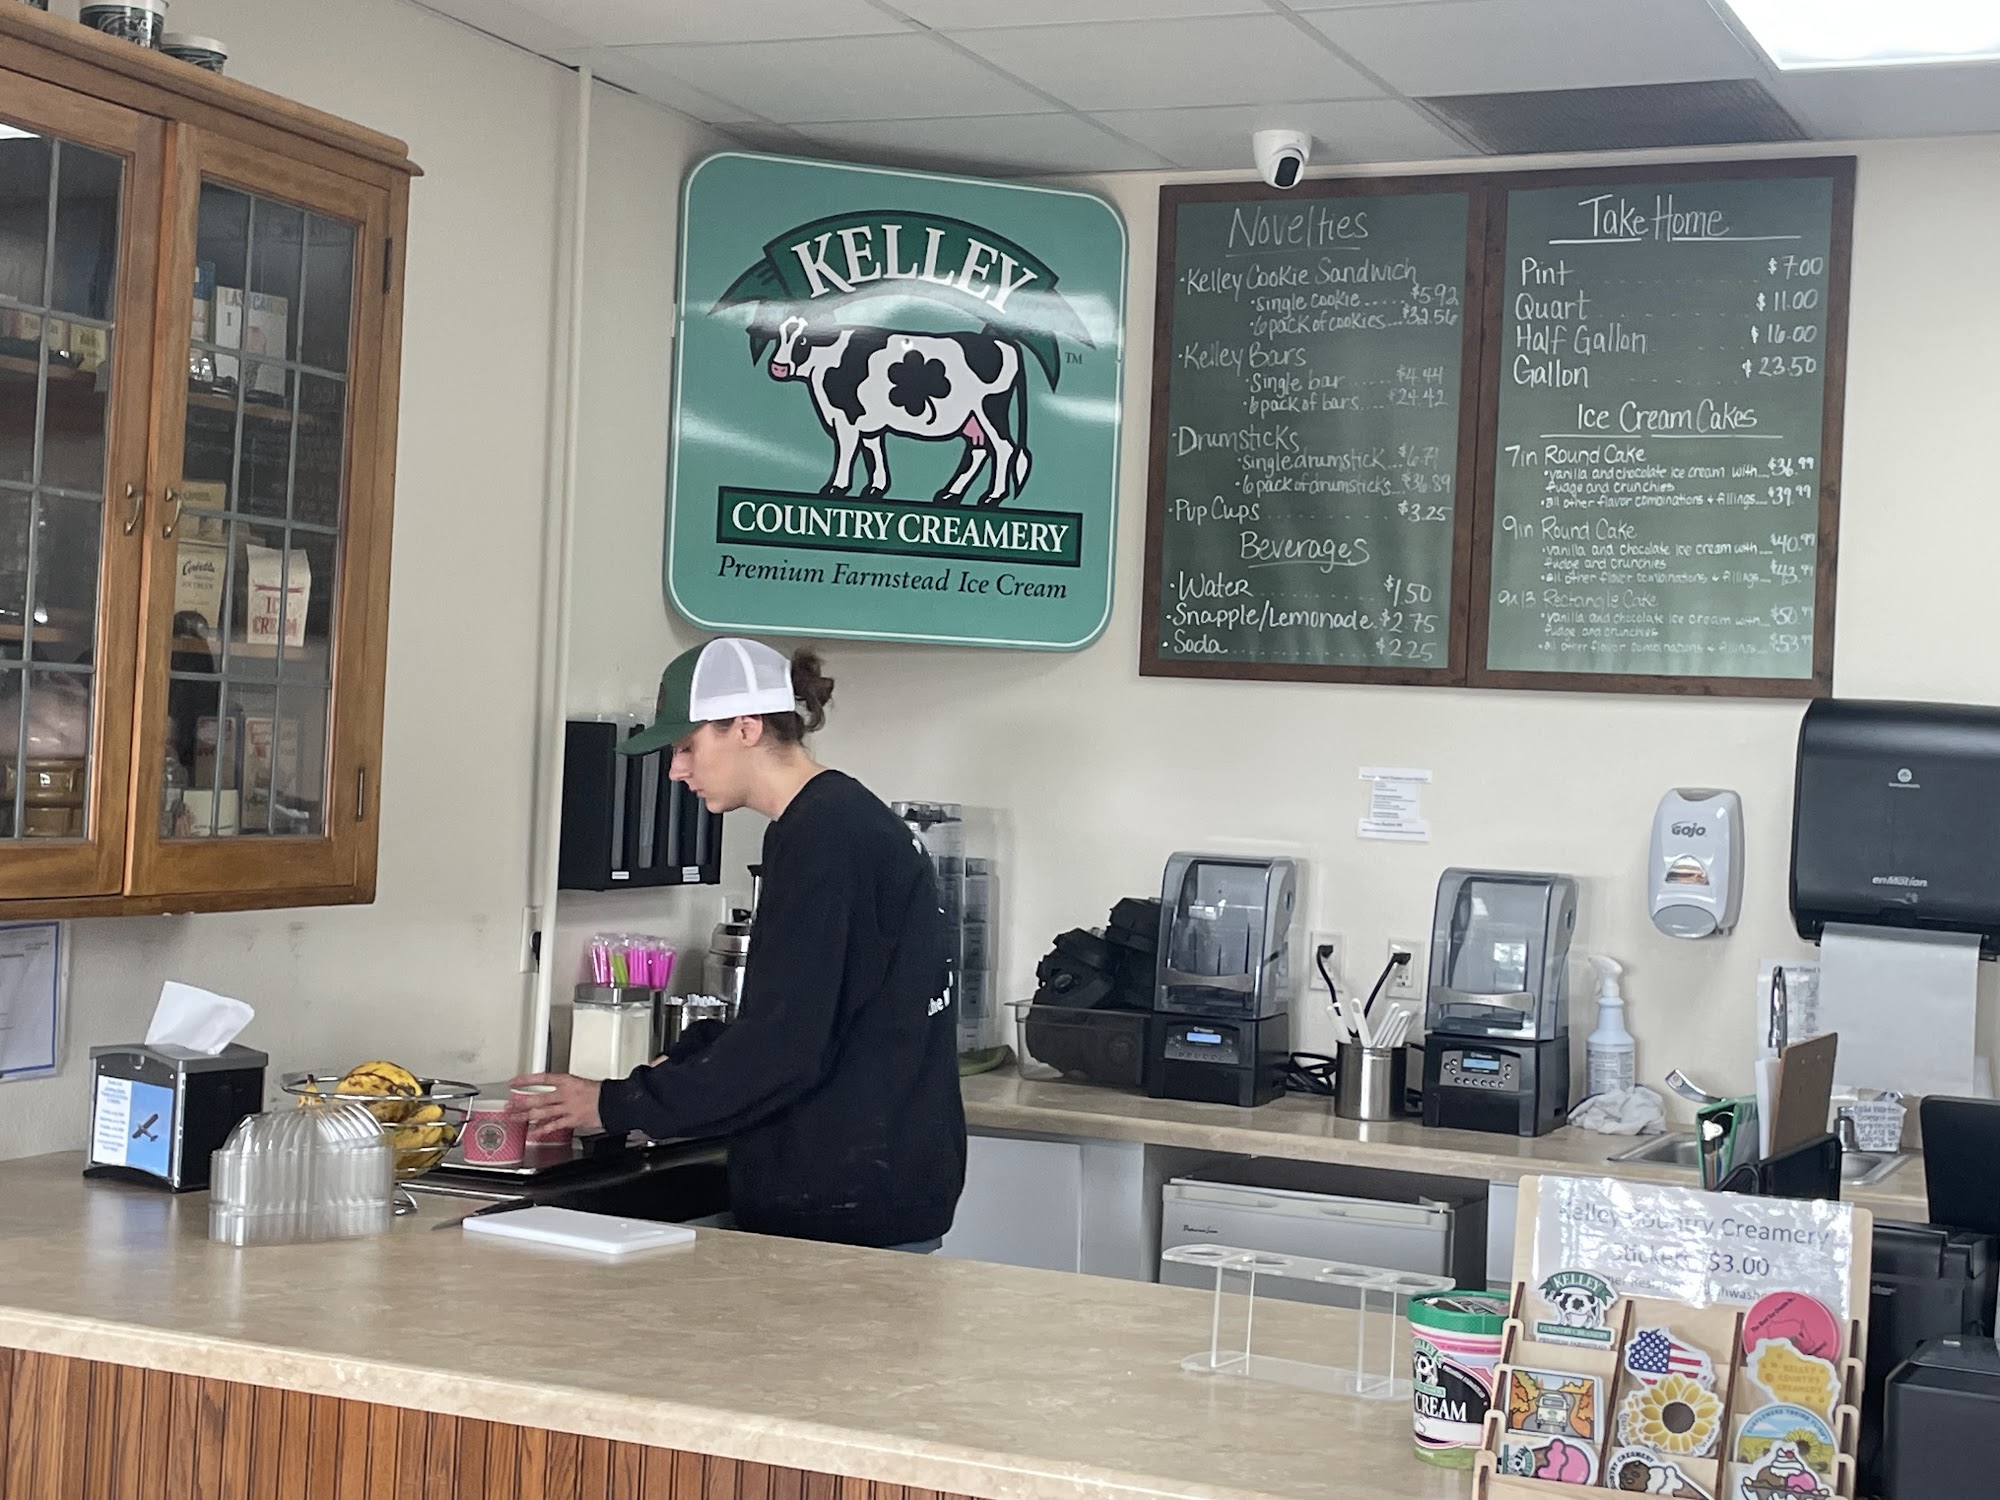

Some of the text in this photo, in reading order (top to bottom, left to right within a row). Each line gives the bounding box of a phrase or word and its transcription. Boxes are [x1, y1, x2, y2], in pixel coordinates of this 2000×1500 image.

[1228, 205, 1369, 248] Novelties
[1578, 194, 1729, 242] Take Home
[791, 224, 1037, 313] KELLEY
[1187, 268, 1242, 301] Kelley
[1315, 257, 1417, 285] Sandwich
[1521, 256, 1575, 286] Pint
[1256, 283, 1459, 319] single cookie $5.92
[1402, 303, 1458, 325] $32.56
[1515, 289, 1591, 321] Quart
[1516, 323, 1567, 355] Half
[1574, 322, 1646, 356] Gallon
[1065, 352, 1083, 365] TM
[1184, 341, 1307, 376] Kelley Bars
[1513, 354, 1589, 388] Gallon
[1308, 369, 1345, 390] bar
[1396, 365, 1443, 385] $4.44
[1322, 394, 1359, 411] bars
[1388, 387, 1448, 408] $24.42
[1578, 398, 1757, 431] Ice Cream Cakes
[1178, 424, 1300, 456] Drumsticks
[1545, 445, 1600, 466] Round
[1603, 444, 1647, 464] Cake
[1242, 452, 1294, 478] single
[1550, 467, 1587, 480] vanilla
[1592, 466, 1614, 479] and
[1615, 464, 1667, 479] chocolate
[1688, 466, 1725, 478] cream
[1732, 464, 1757, 478] with
[1546, 481, 1675, 497] fudge and crunchies
[1546, 497, 1560, 508] all
[1563, 496, 1595, 509] other
[1597, 495, 1633, 508] flavor
[1175, 496, 1453, 525] Pup Cups $3.25
[732, 501, 1069, 553] COUNTRY CREAMERY
[1541, 516, 1590, 540] Round
[1596, 518, 1638, 540] Cake
[1240, 530, 1369, 573] Beverages
[1546, 544, 1586, 556] vanilla
[1592, 544, 1614, 556] and
[1620, 541, 1670, 556] chocolate
[1695, 544, 1732, 555] cream
[1734, 542, 1758, 555] with
[1584, 558, 1607, 569] and
[1610, 558, 1667, 569] crunchies
[718, 555, 1067, 599] Premium Farmstead Ice Cream
[1384, 574, 1432, 607] $1.50
[1623, 589, 1658, 609] Cake
[252, 615, 297, 635] CREM
[1172, 600, 1438, 634] Snapple/Lemonade $2.75
[1174, 629, 1437, 661] Soda $2.25
[1722, 1218, 1830, 1246] Creamery
[1709, 1252, 1770, 1276] $3.00
[1553, 1274, 1600, 1291] KELLEY
[1415, 1391, 1467, 1422] CREAM
